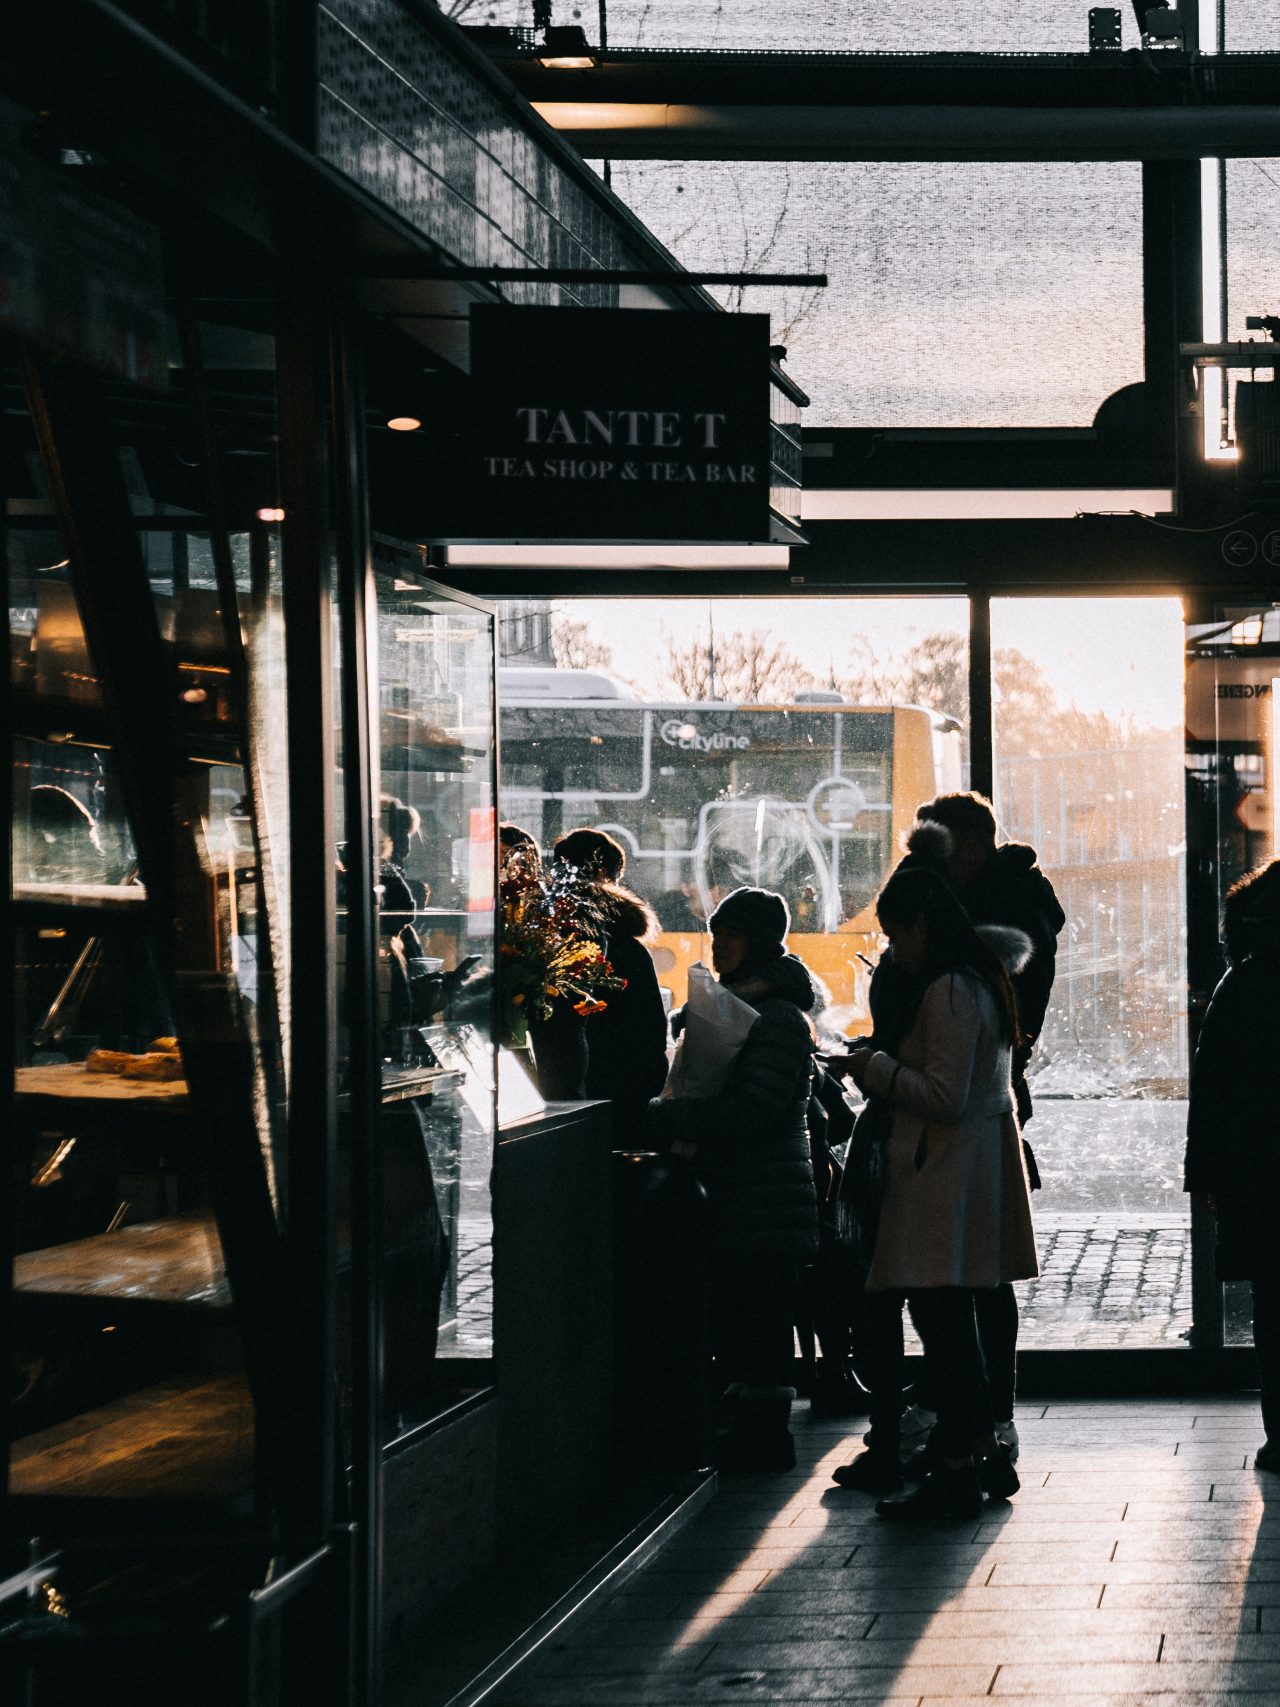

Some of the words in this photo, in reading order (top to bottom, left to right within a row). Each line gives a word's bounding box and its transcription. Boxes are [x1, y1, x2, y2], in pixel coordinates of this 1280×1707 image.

[516, 407, 682, 447] TANTE
[694, 412, 727, 449] T
[483, 456, 536, 478] TEA
[543, 458, 614, 481] SHOP
[620, 461, 640, 481] &
[647, 462, 698, 483] TEA
[705, 463, 757, 484] BAR
